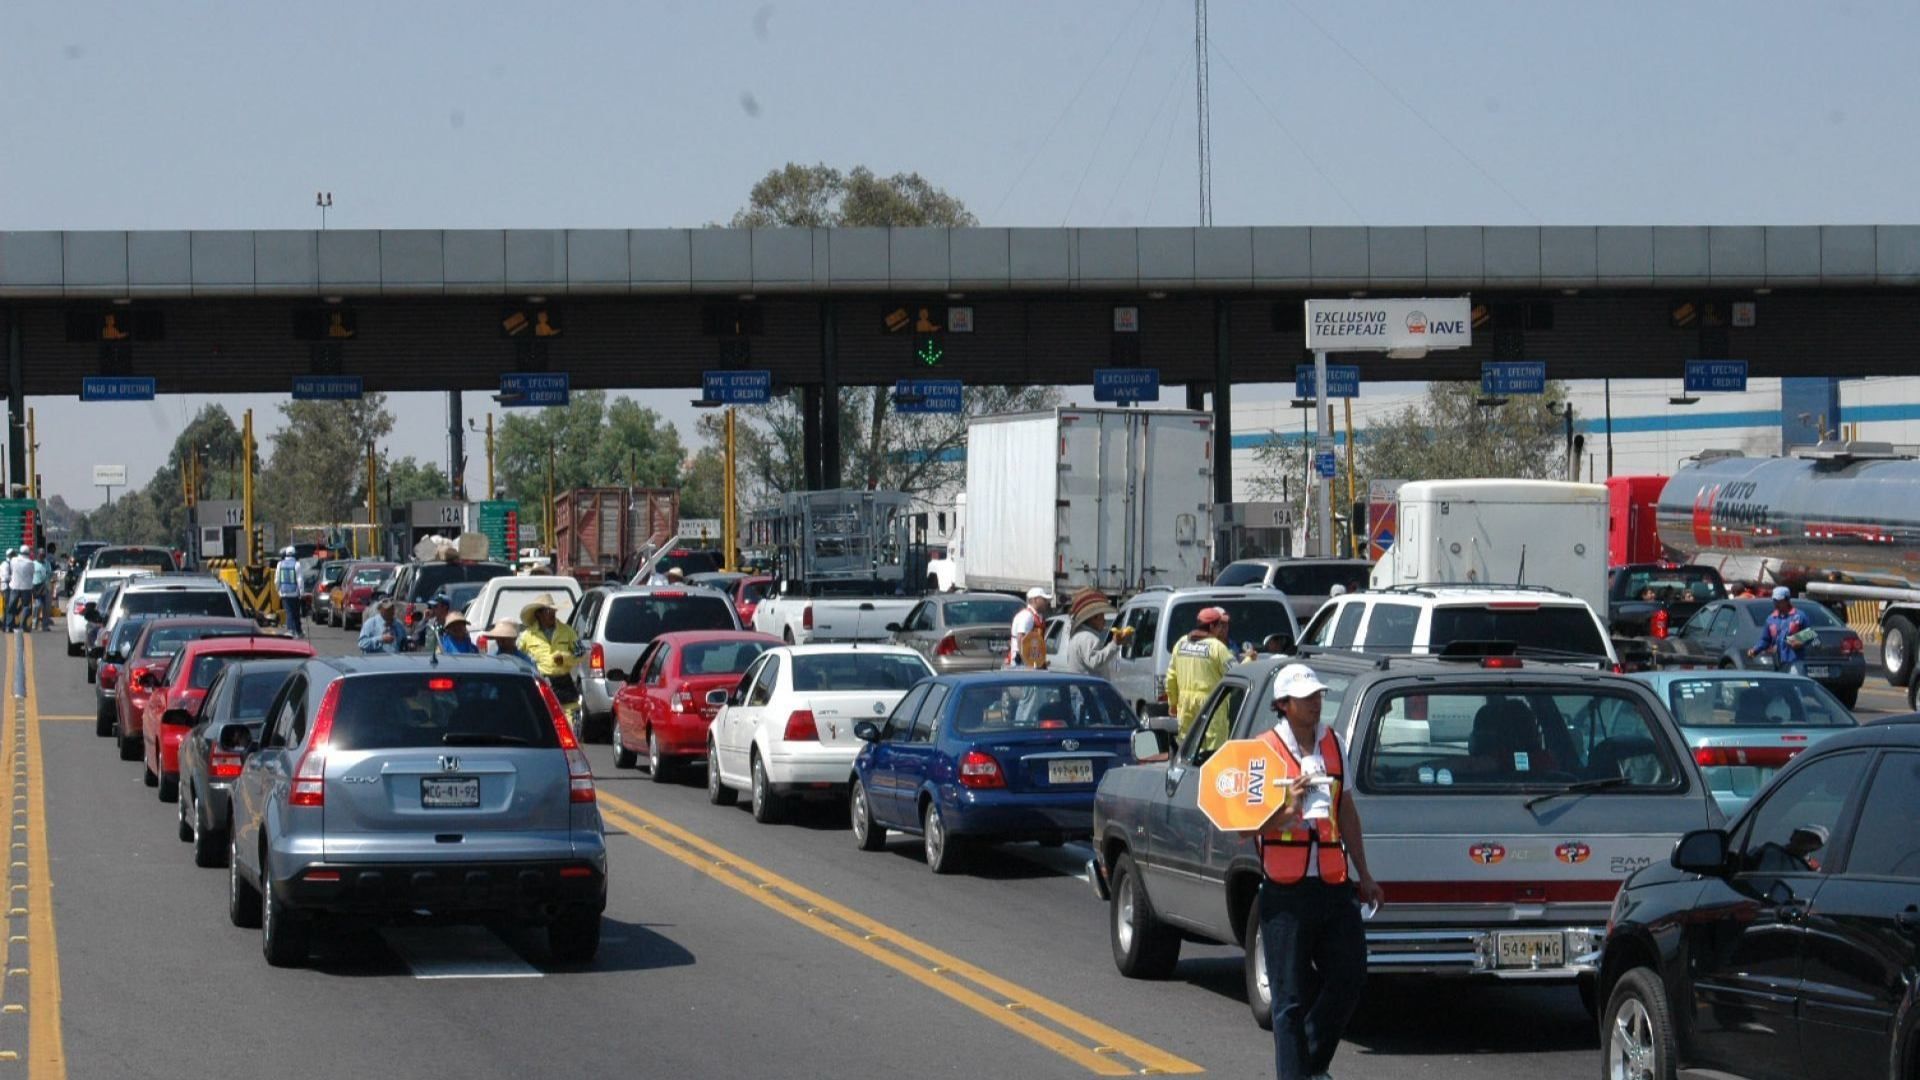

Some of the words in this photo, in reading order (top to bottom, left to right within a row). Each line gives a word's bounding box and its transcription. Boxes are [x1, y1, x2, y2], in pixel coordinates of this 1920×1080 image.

[1314, 311, 1387, 323] EXCLUSIVO
[1315, 323, 1387, 336] TELEPEAJE
[1429, 320, 1465, 334] IAVE
[730, 375, 766, 386] EFECTIVO
[1102, 374, 1151, 385] EXCLUSIVO
[87, 384, 105, 394] PAGO
[108, 384, 117, 394] EN
[733, 389, 765, 399] CREDITO
[923, 385, 959, 396] EFECTIVO
[1113, 388, 1140, 397] IAVE
[925, 398, 957, 409] CREDITO
[1719, 481, 1757, 500] AUTO
[1716, 501, 1769, 525] TANQUES
[1247, 759, 1266, 804] IAVE
[1610, 856, 1650, 865] RAM
